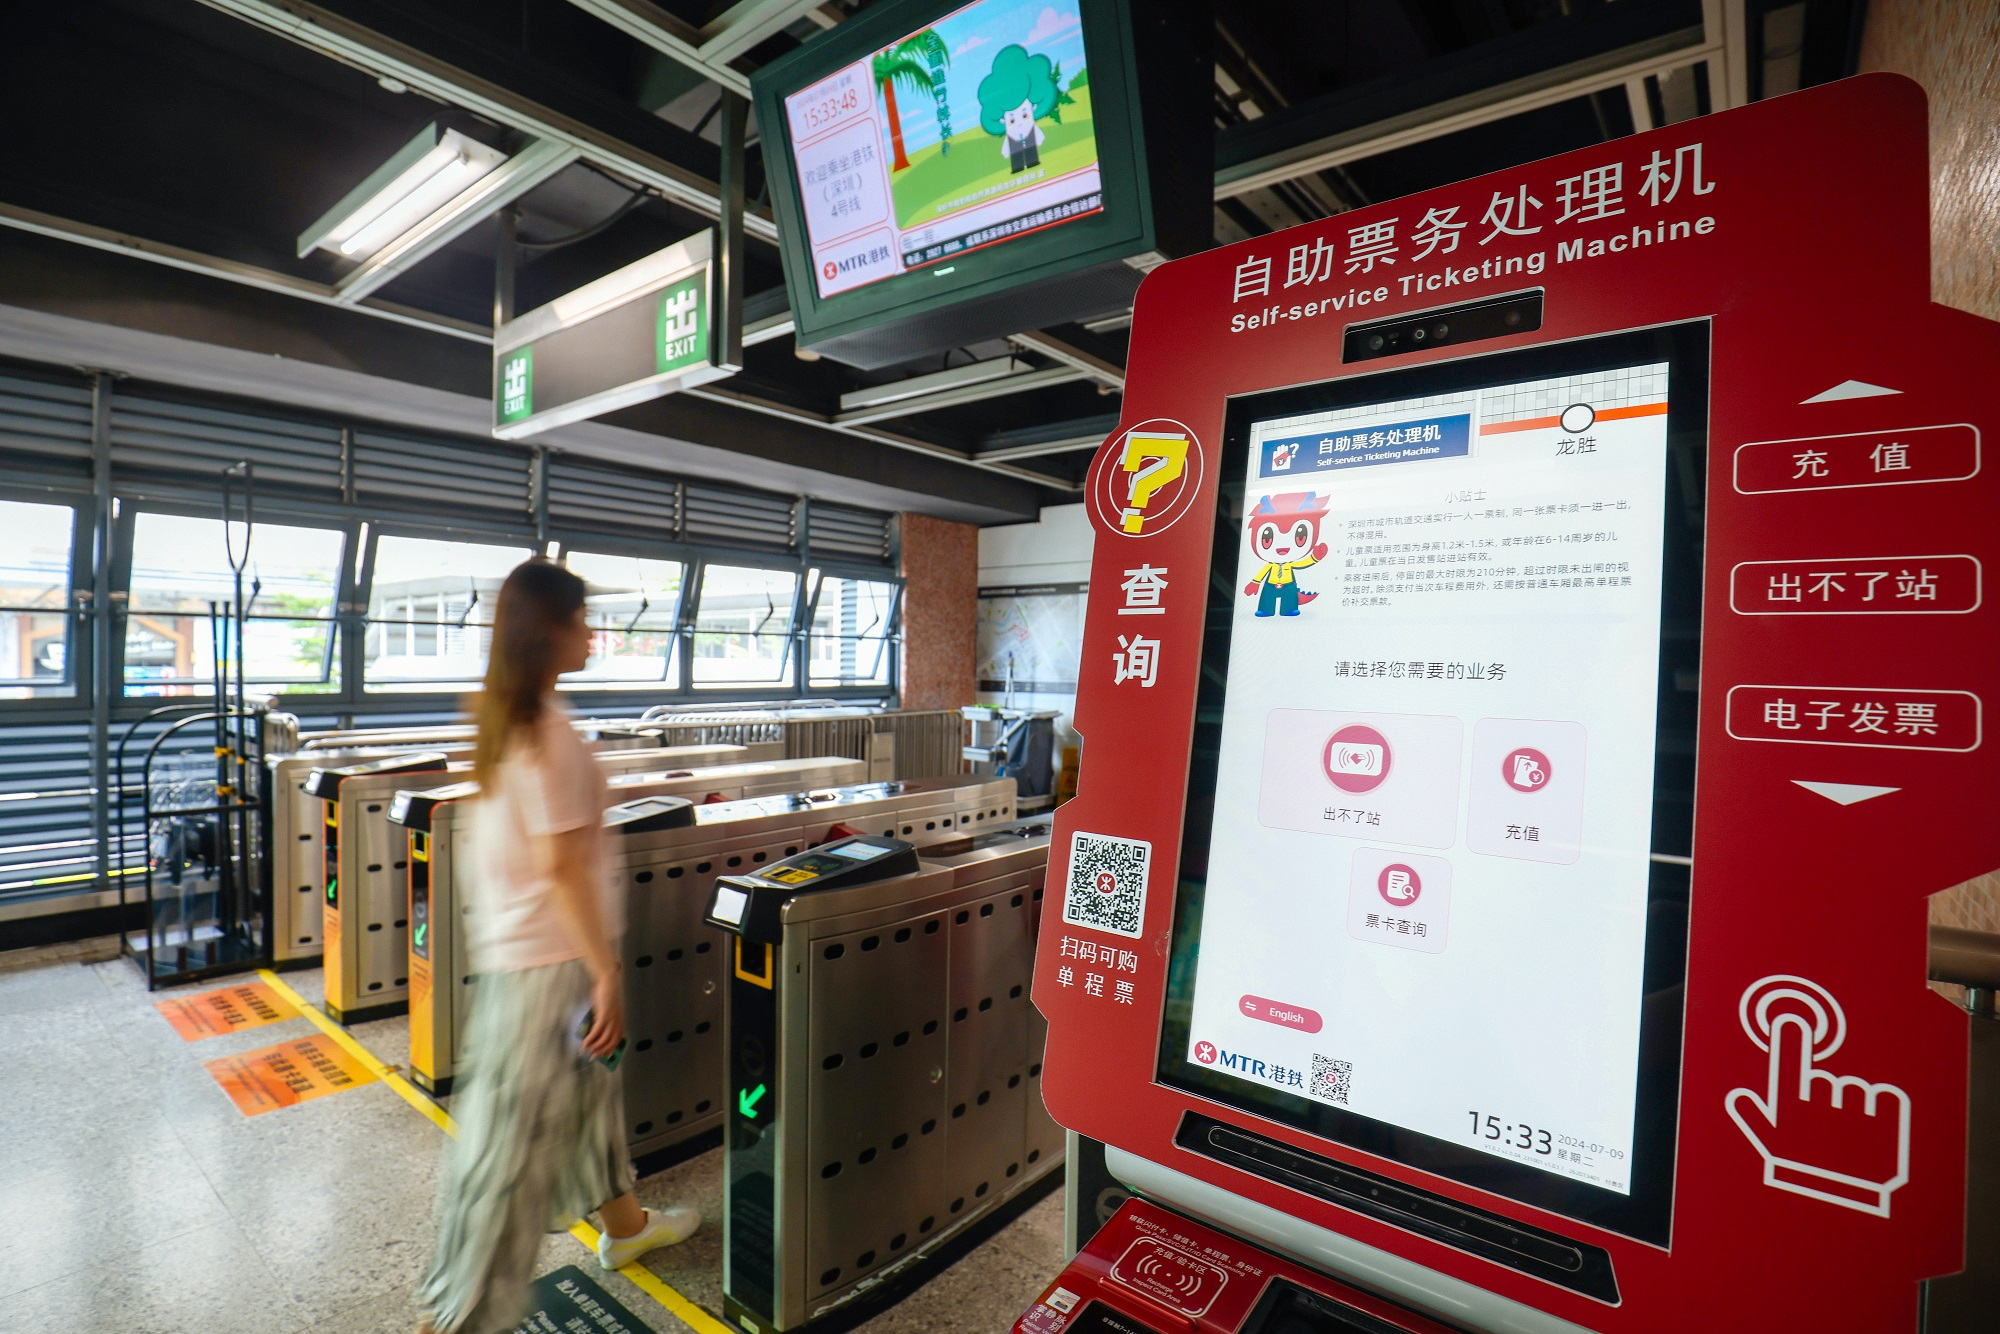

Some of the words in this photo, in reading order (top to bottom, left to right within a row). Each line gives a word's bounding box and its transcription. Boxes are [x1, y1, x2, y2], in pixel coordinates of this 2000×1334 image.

[804, 88, 857, 129] 15:33:48
[804, 145, 876, 186] 欢迎乘坐港铁
[830, 199, 862, 218] 4号线
[1231, 142, 1716, 304] 自助票务处理机
[838, 254, 868, 274] MTR
[869, 246, 891, 265] 港铁
[1230, 284, 1388, 333] Self-service
[1398, 250, 1546, 297] Ticketing
[1557, 214, 1716, 263] Machine
[665, 288, 697, 342] 出
[665, 335, 697, 361] EXIT
[504, 357, 526, 400] 出
[504, 395, 525, 415] EXIT
[1318, 424, 1441, 455] 自助票务处理机
[1554, 437, 1597, 457] 龙胜
[1316, 453, 1362, 468] Self-service
[1363, 449, 1401, 464] Ticketing
[1402, 444, 1440, 458] Machine
[1792, 442, 1911, 480] 充值
[1444, 489, 1487, 504] 小贴士
[1766, 569, 1939, 602] 出不了站
[1111, 562, 1170, 688] 查询
[1334, 661, 1507, 682] 请选择您需要的业务
[1763, 698, 1939, 736] 电子发票
[1323, 806, 1382, 827] 出不了站
[1505, 823, 1540, 843] 充值
[1365, 912, 1428, 939] 票卡查询
[1060, 935, 1139, 975] 扫码可购
[1056, 965, 1135, 1006] 单程票
[1269, 1005, 1304, 1026] English
[1219, 1050, 1266, 1079] MTR
[1268, 1062, 1305, 1091] 港铁
[1469, 1110, 1553, 1156] 15:33
[1558, 1133, 1625, 1161] 2024-07-09
[1557, 1148, 1595, 1169] 星期二
[1135, 1225, 1151, 1235] Quick
[1201, 1253, 1217, 1265] Card
[1217, 1260, 1246, 1277] Scanning
[1153, 1246, 1208, 1276] 充值/验卡区
[1133, 1277, 1152, 1290] Inspect
[1152, 1287, 1167, 1297] Card
[1167, 1294, 1181, 1304] Area
[1147, 1277, 1174, 1293] Recharge
